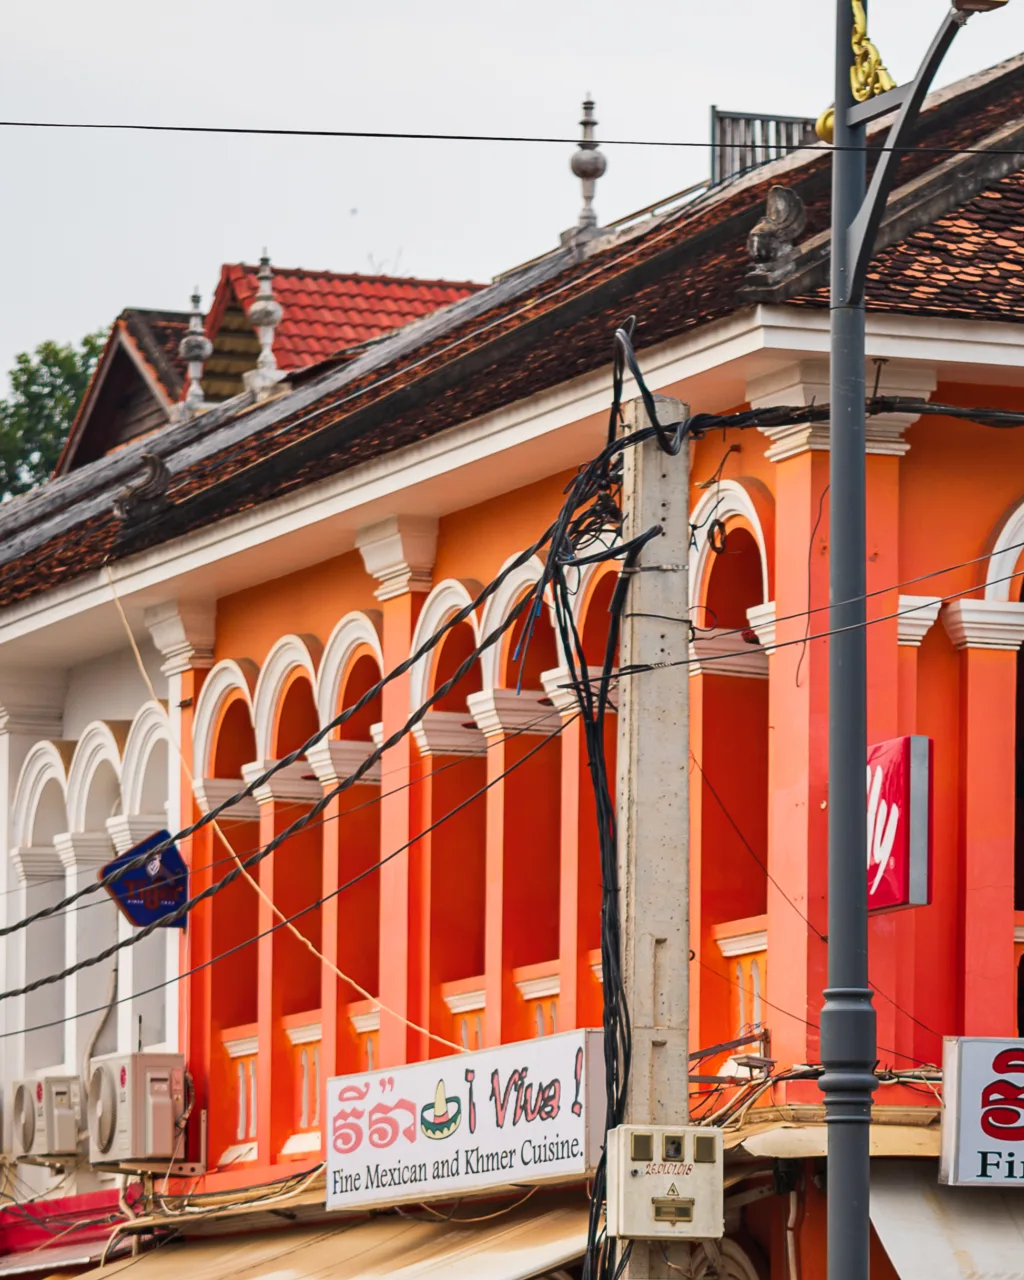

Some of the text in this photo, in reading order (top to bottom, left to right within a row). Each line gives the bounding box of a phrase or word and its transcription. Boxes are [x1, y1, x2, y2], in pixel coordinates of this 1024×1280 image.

[332, 1134, 584, 1195] Fine Mexican and Khmer Cuisine.
